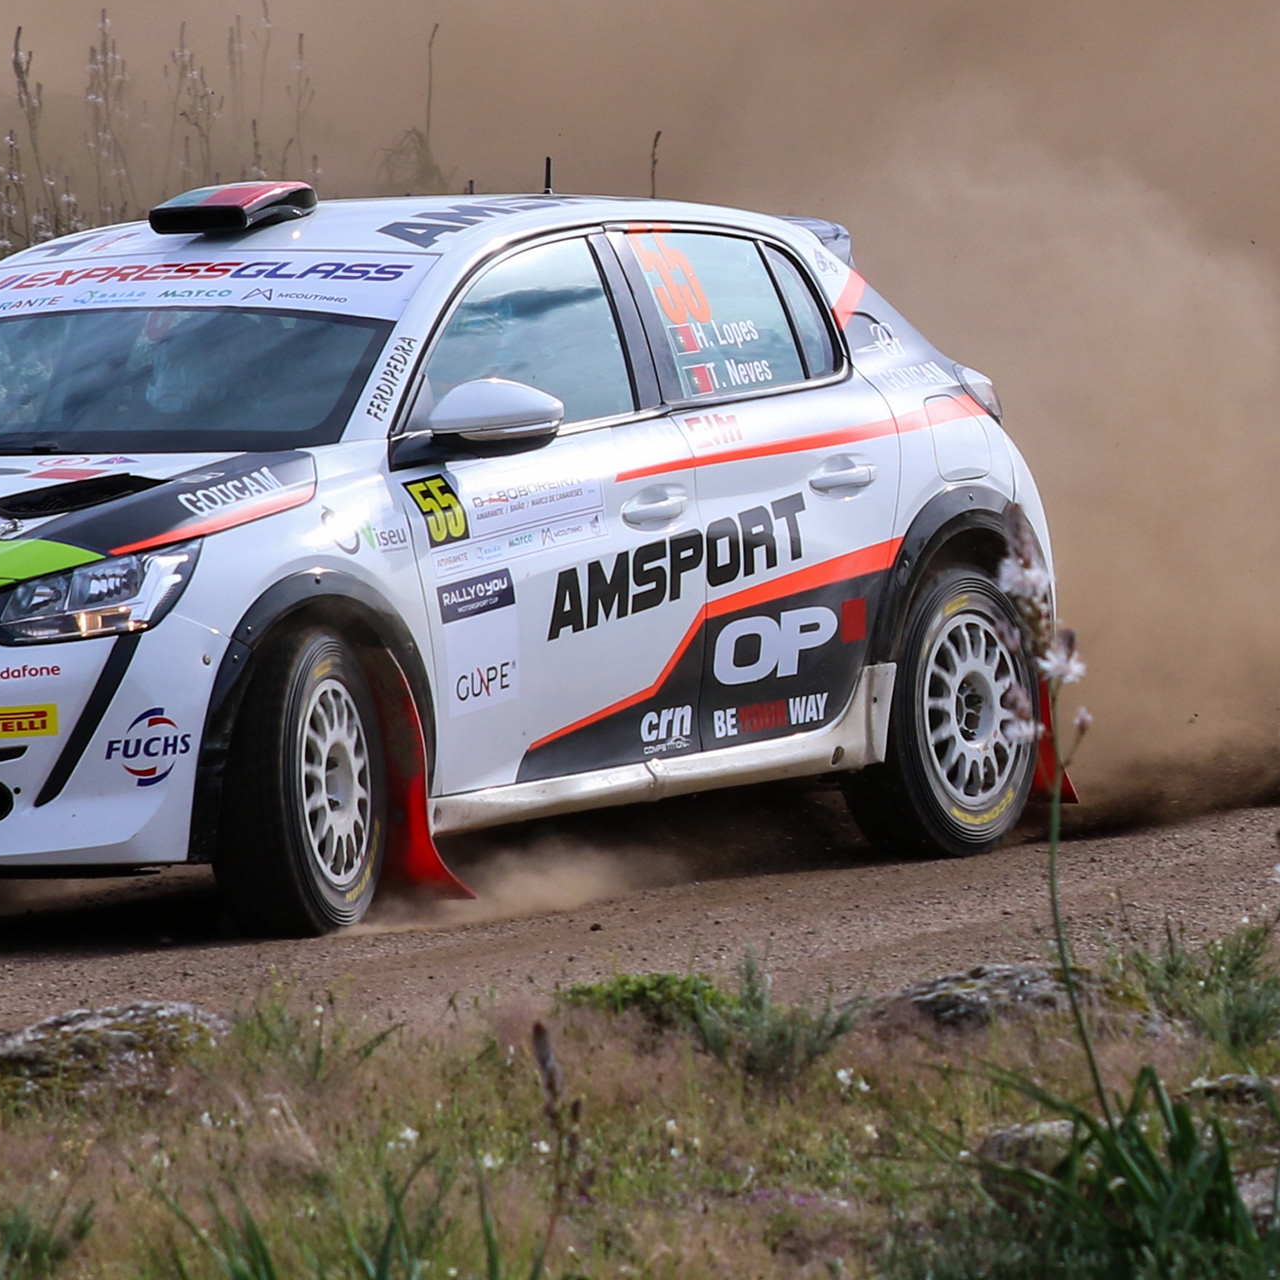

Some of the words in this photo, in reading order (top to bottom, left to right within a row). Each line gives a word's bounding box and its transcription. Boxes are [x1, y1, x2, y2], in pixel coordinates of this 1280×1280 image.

[10, 261, 415, 291] EXPRESSGLASS
[628, 222, 712, 324] 55
[277, 292, 348, 304] MCOUTINHO
[690, 322, 715, 349] H.
[710, 319, 760, 349] Lopes
[366, 336, 418, 422] FERDIPEDRA
[705, 362, 728, 389] T.
[724, 359, 773, 387] Neves
[177, 466, 283, 518] GOUCAM
[406, 477, 467, 543] 55
[476, 507, 504, 521] AMARANTE
[546, 491, 806, 642] AMSPORT
[713, 606, 839, 686] OP
[640, 704, 693, 743] crn
[713, 707, 739, 739] BE
[738, 699, 789, 733] YOUR
[788, 692, 829, 726] WAY
[105, 733, 192, 761] FUCHS
